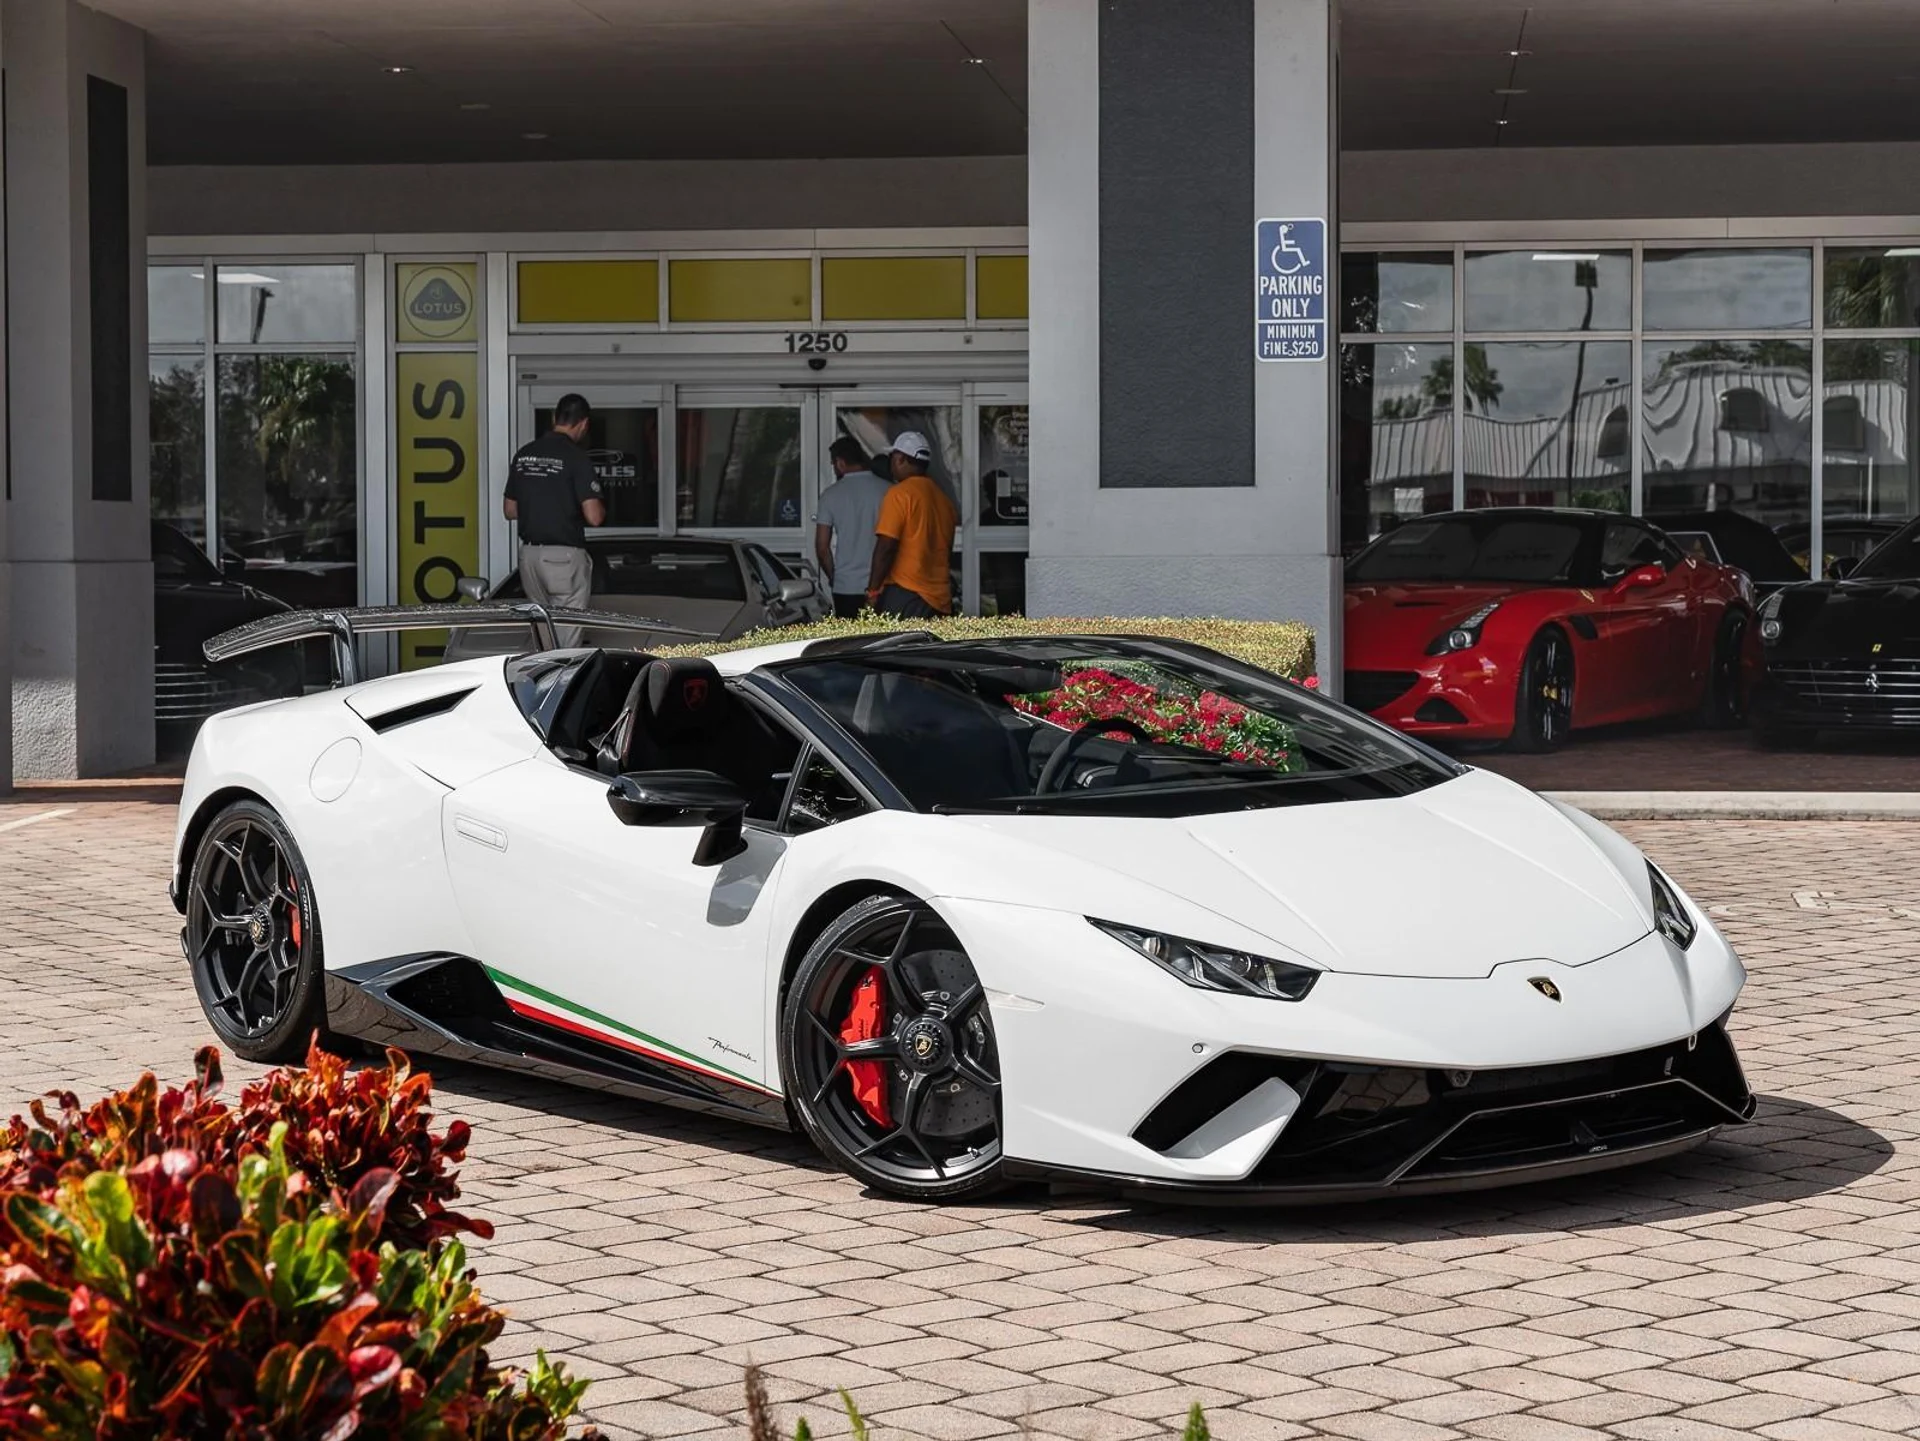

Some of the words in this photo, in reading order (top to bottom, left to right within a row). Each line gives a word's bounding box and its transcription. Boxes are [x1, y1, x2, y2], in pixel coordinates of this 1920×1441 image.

[1260, 275, 1322, 294] PARKING
[415, 302, 462, 314] LOTUS
[1272, 298, 1310, 317] ONLY
[1267, 325, 1316, 339] MINIMUM
[784, 332, 848, 353] 1250
[1263, 341, 1288, 355] FINE
[1292, 340, 1319, 356] $250
